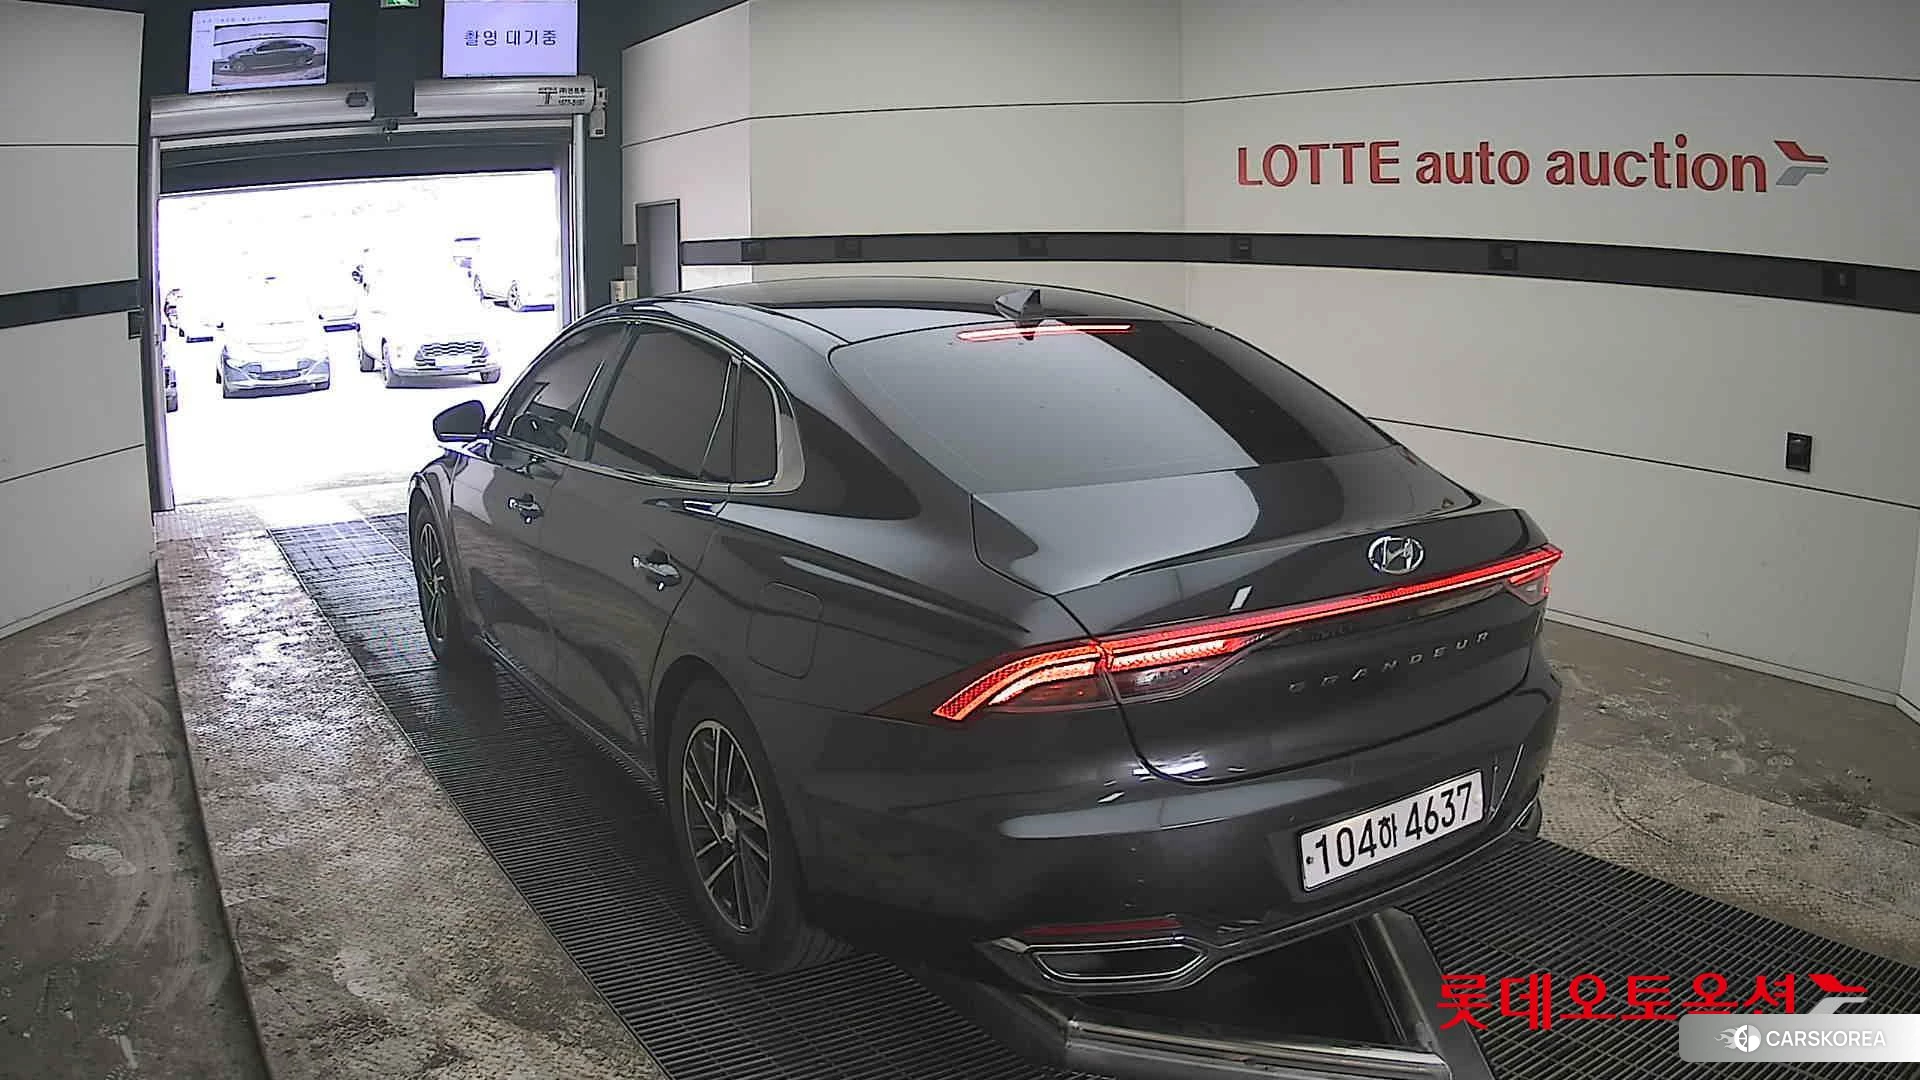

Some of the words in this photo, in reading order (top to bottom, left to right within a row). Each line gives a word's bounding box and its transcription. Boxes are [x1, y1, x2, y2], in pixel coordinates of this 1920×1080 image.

[464, 29, 497, 46] 촬영
[1238, 141, 1400, 186] LOTTE
[1415, 141, 1530, 185] auto
[1545, 134, 1767, 193] auction
[1289, 631, 1489, 693] GRANDEUR
